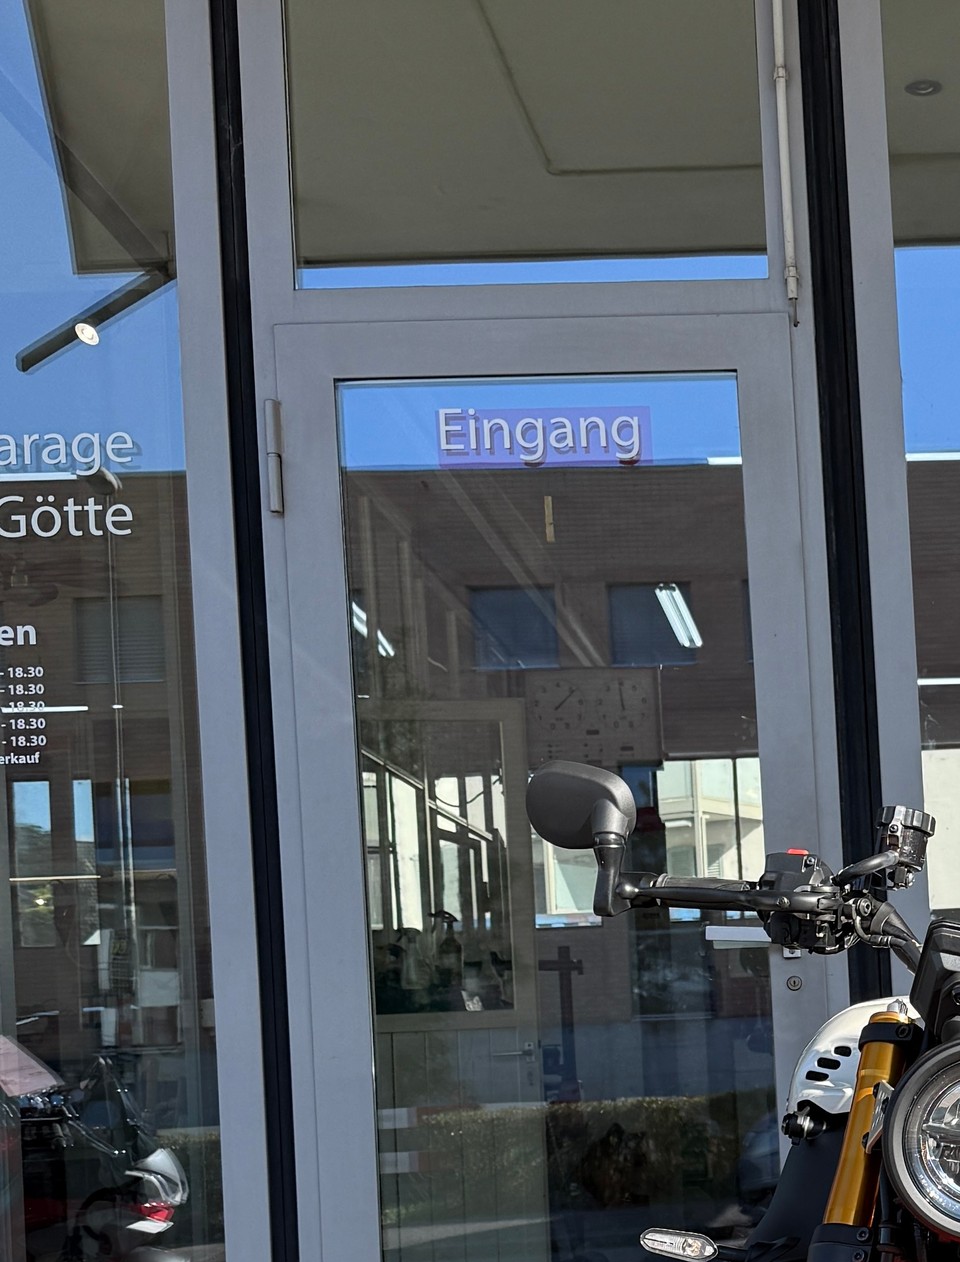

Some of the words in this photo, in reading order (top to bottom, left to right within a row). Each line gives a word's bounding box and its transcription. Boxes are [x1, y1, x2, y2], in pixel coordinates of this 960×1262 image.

[438, 407, 641, 461] Eingang
[0, 431, 134, 476] arage
[0, 494, 134, 538] Götte
[7, 666, 44, 678] 18.30
[8, 683, 45, 695] 18.30
[9, 718, 46, 729] 18.30
[10, 735, 47, 747] 18.30
